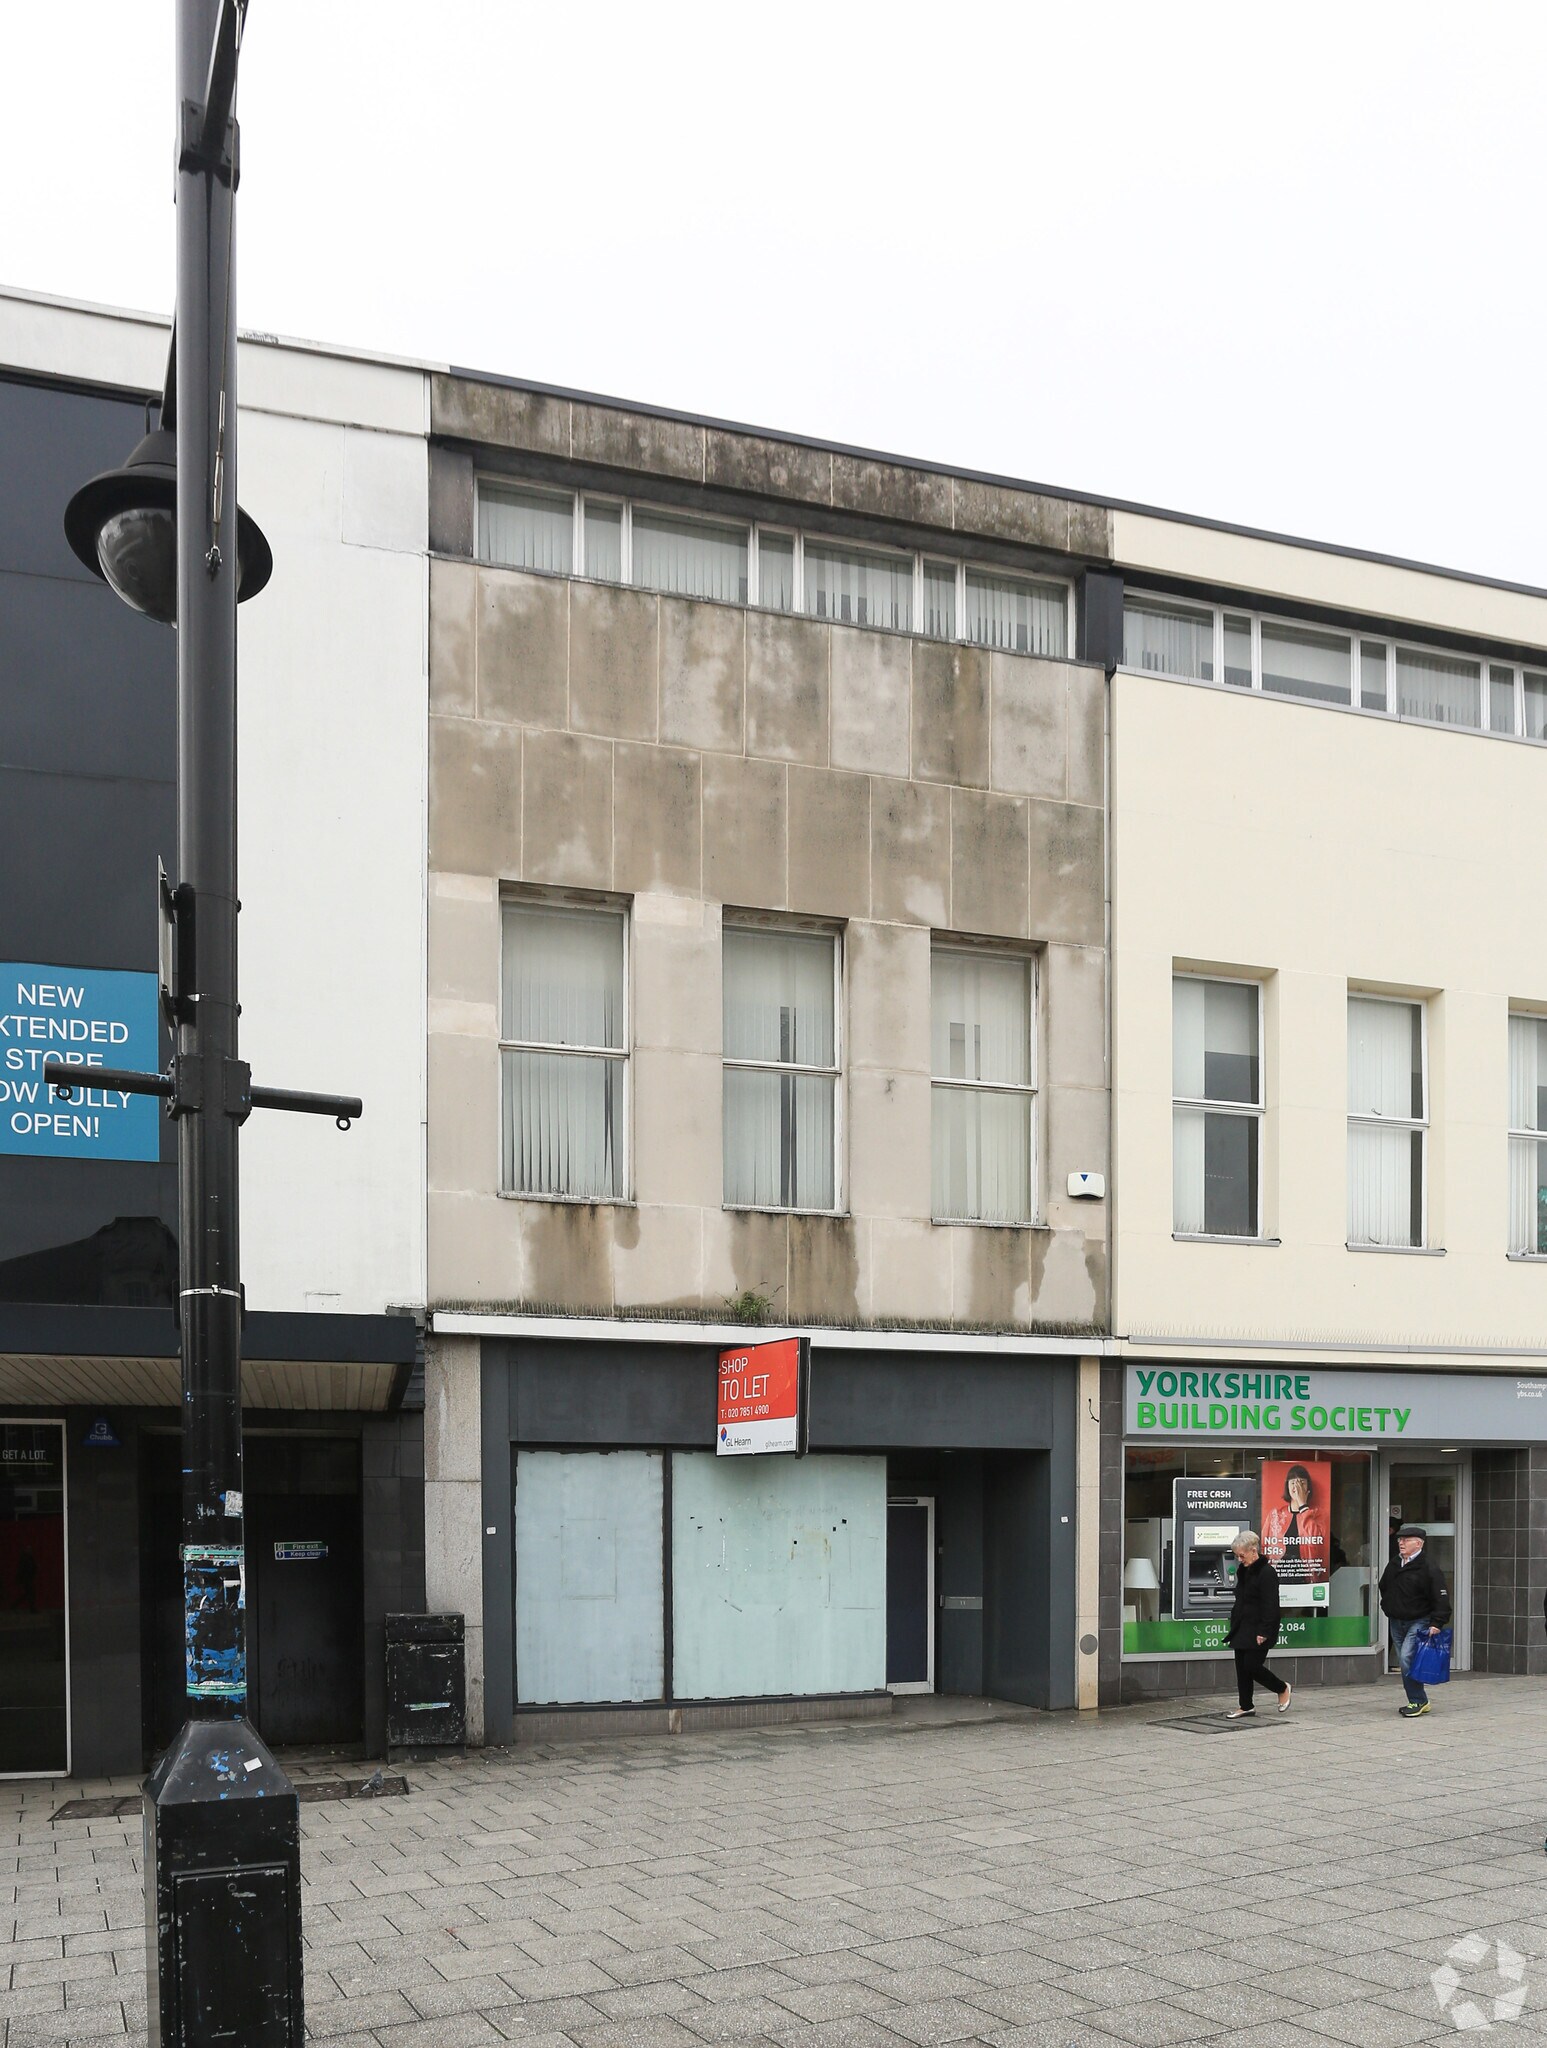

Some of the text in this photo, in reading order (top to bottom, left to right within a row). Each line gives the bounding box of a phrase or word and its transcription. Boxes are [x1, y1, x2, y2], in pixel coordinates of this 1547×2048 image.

[17, 982, 85, 1008] NEW
[10, 1112, 100, 1138] OPEN!
[721, 1357, 749, 1375] SHOP
[721, 1374, 770, 1401] TO LET
[1136, 1369, 1311, 1401] YORKSHIRE
[727, 1408, 739, 1418] 020
[739, 1406, 753, 1417] 7851
[754, 1404, 769, 1414] 4900
[1136, 1401, 1412, 1433] BUILDING SOCIETY
[89, 1433, 113, 1441] Chubb
[725, 1437, 752, 1448] GL Hearn
[764, 1439, 794, 1450] glhearn.com
[2, 1449, 18, 1460] GET
[20, 1449, 27, 1460] A
[1186, 1489, 1232, 1499] FREE CASH
[1186, 1500, 1248, 1510] WITHDRAWALS
[1264, 1536, 1324, 1545] NO-BRAINER
[1264, 1547, 1284, 1555] ISAs
[1204, 1624, 1229, 1634] CALL
[1286, 1622, 1306, 1632] 084
[1204, 1638, 1219, 1647] GO
